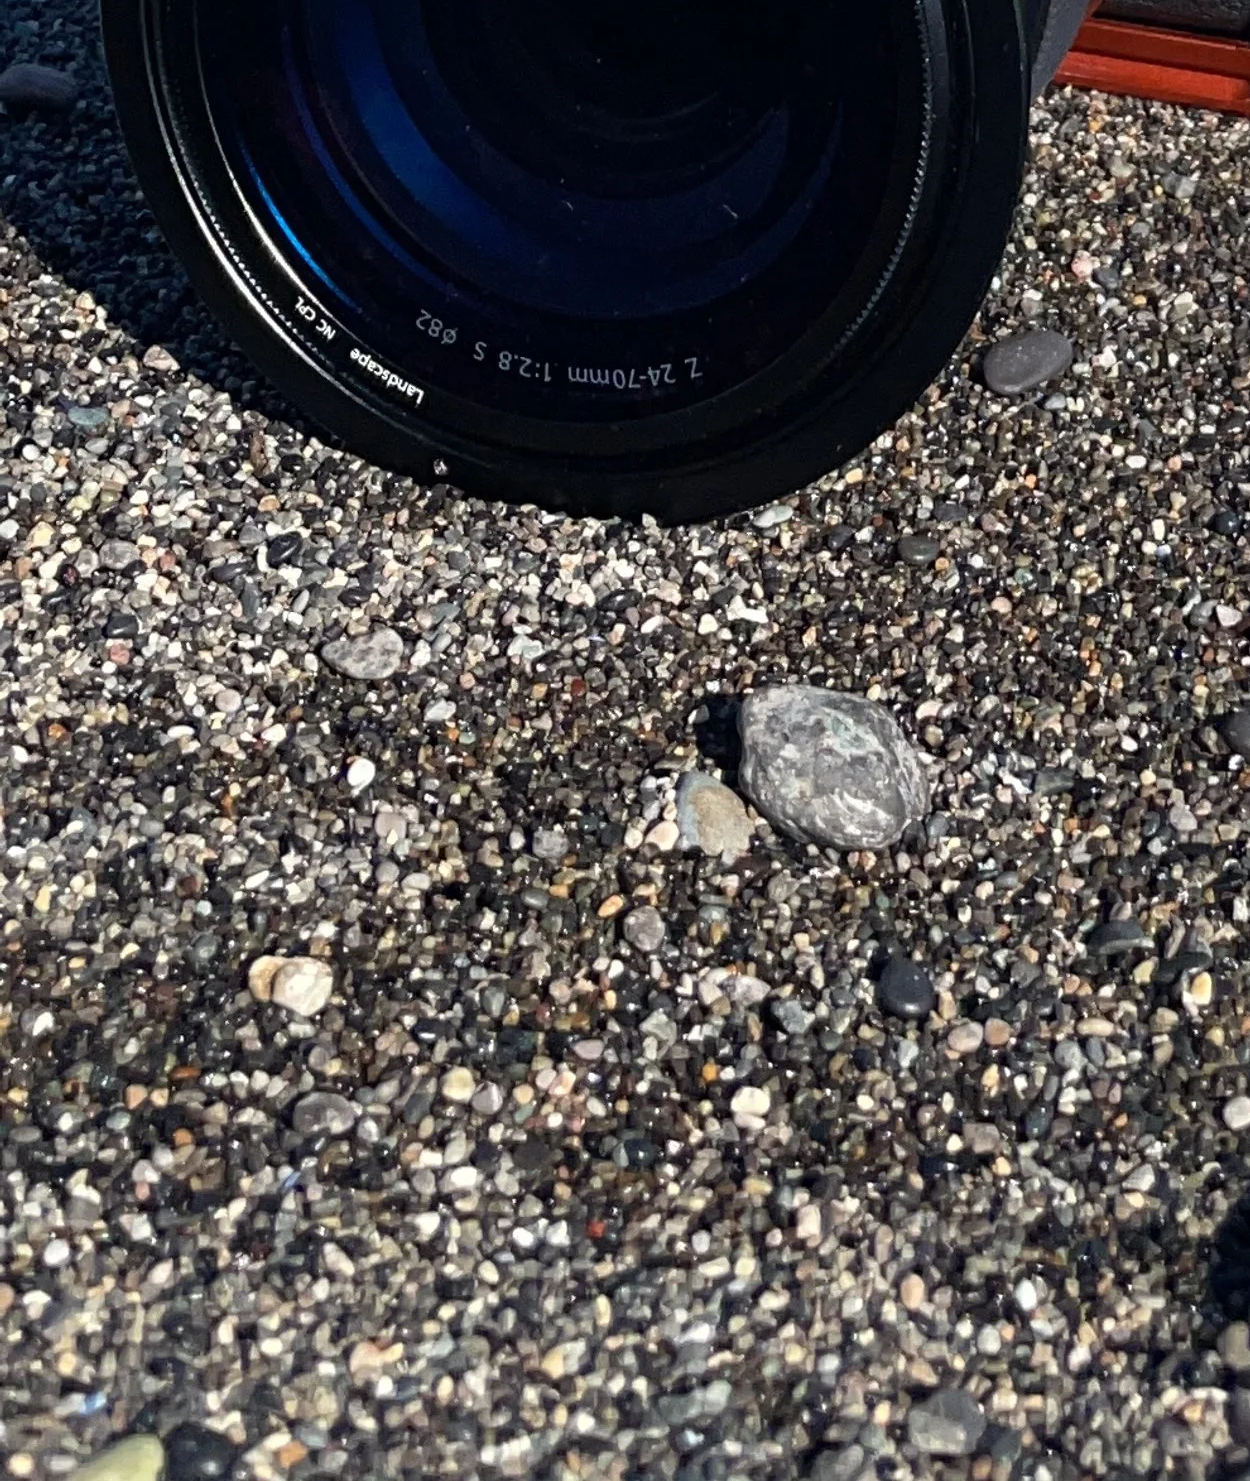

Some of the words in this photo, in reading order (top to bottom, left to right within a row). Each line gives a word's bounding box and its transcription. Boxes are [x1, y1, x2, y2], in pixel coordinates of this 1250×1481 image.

[295, 296, 316, 321] CPL
[315, 319, 336, 341] NC
[473, 341, 487, 361] S
[350, 348, 424, 406] Landscape
[499, 351, 552, 382] 1:2.8
[568, 363, 676, 389] 24-70mm
[685, 357, 703, 379] Z
